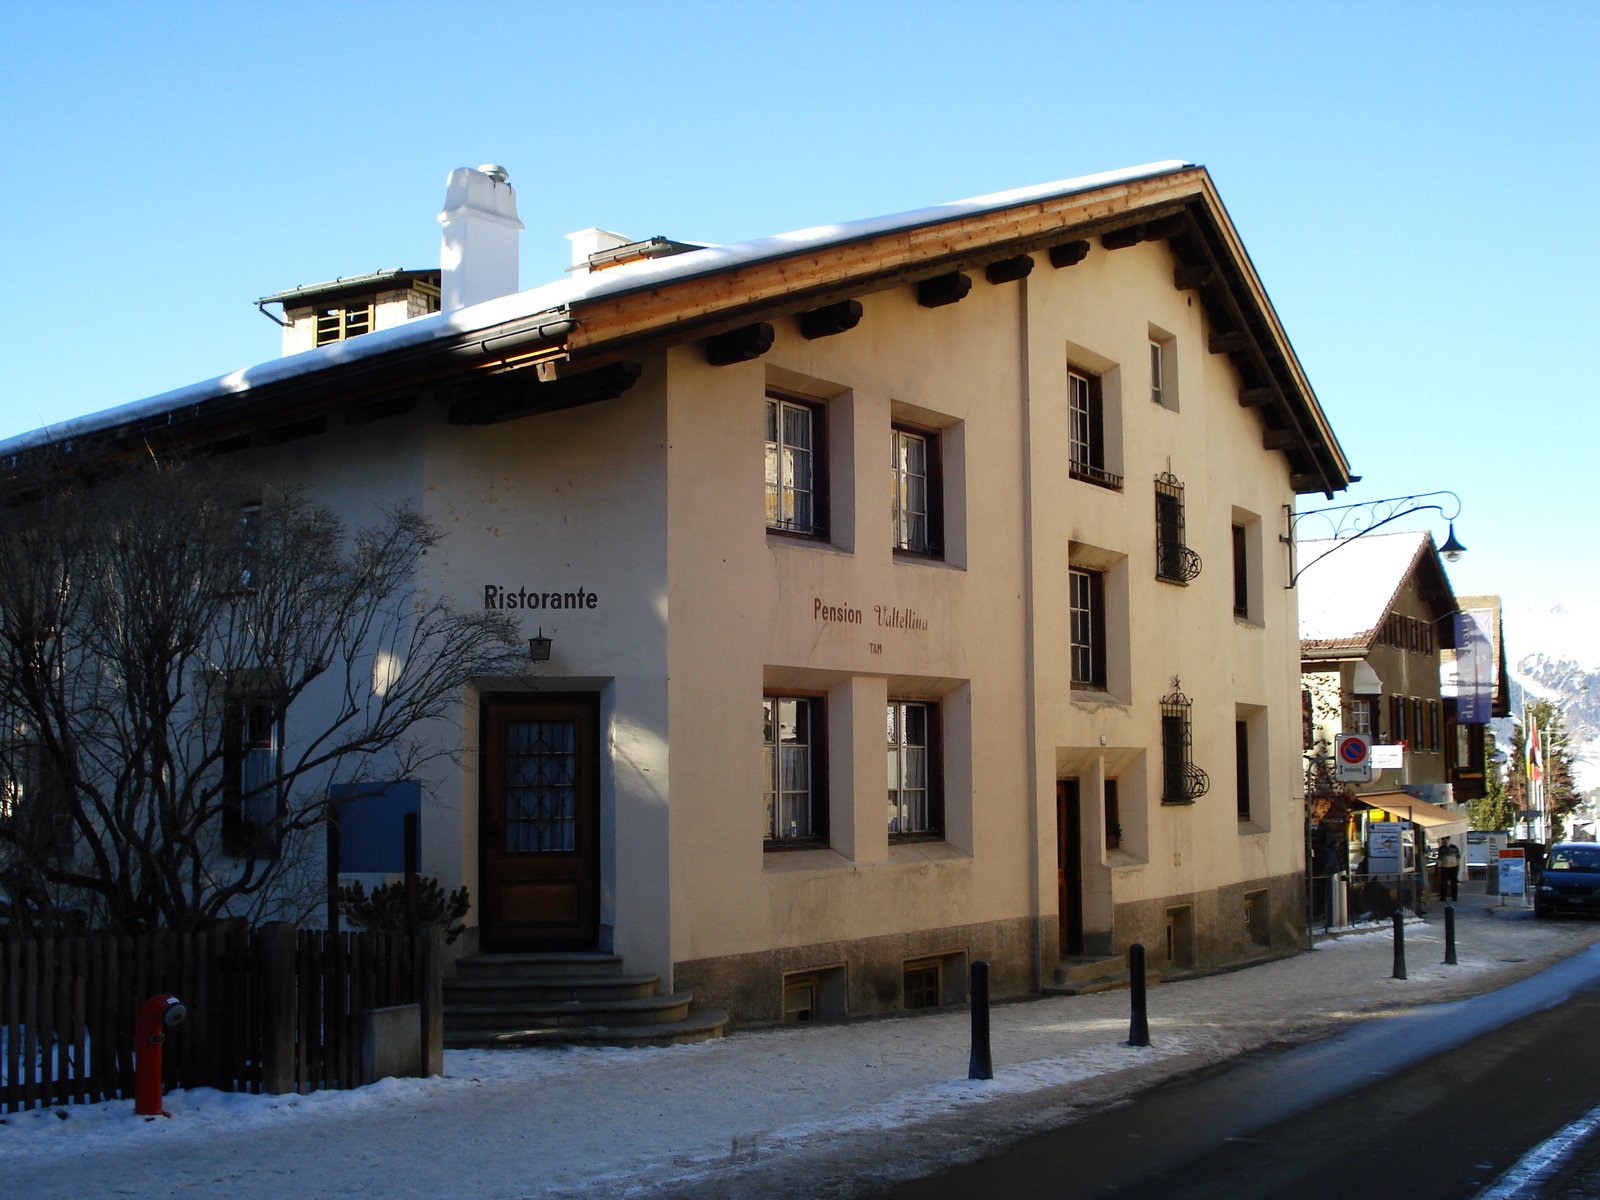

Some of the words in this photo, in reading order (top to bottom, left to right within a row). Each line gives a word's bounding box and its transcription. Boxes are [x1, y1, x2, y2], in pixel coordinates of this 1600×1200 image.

[484, 584, 598, 609] Ristorante
[814, 597, 862, 624] Pension
[873, 604, 929, 631] Valtellina
[869, 643, 883, 655] TAM
